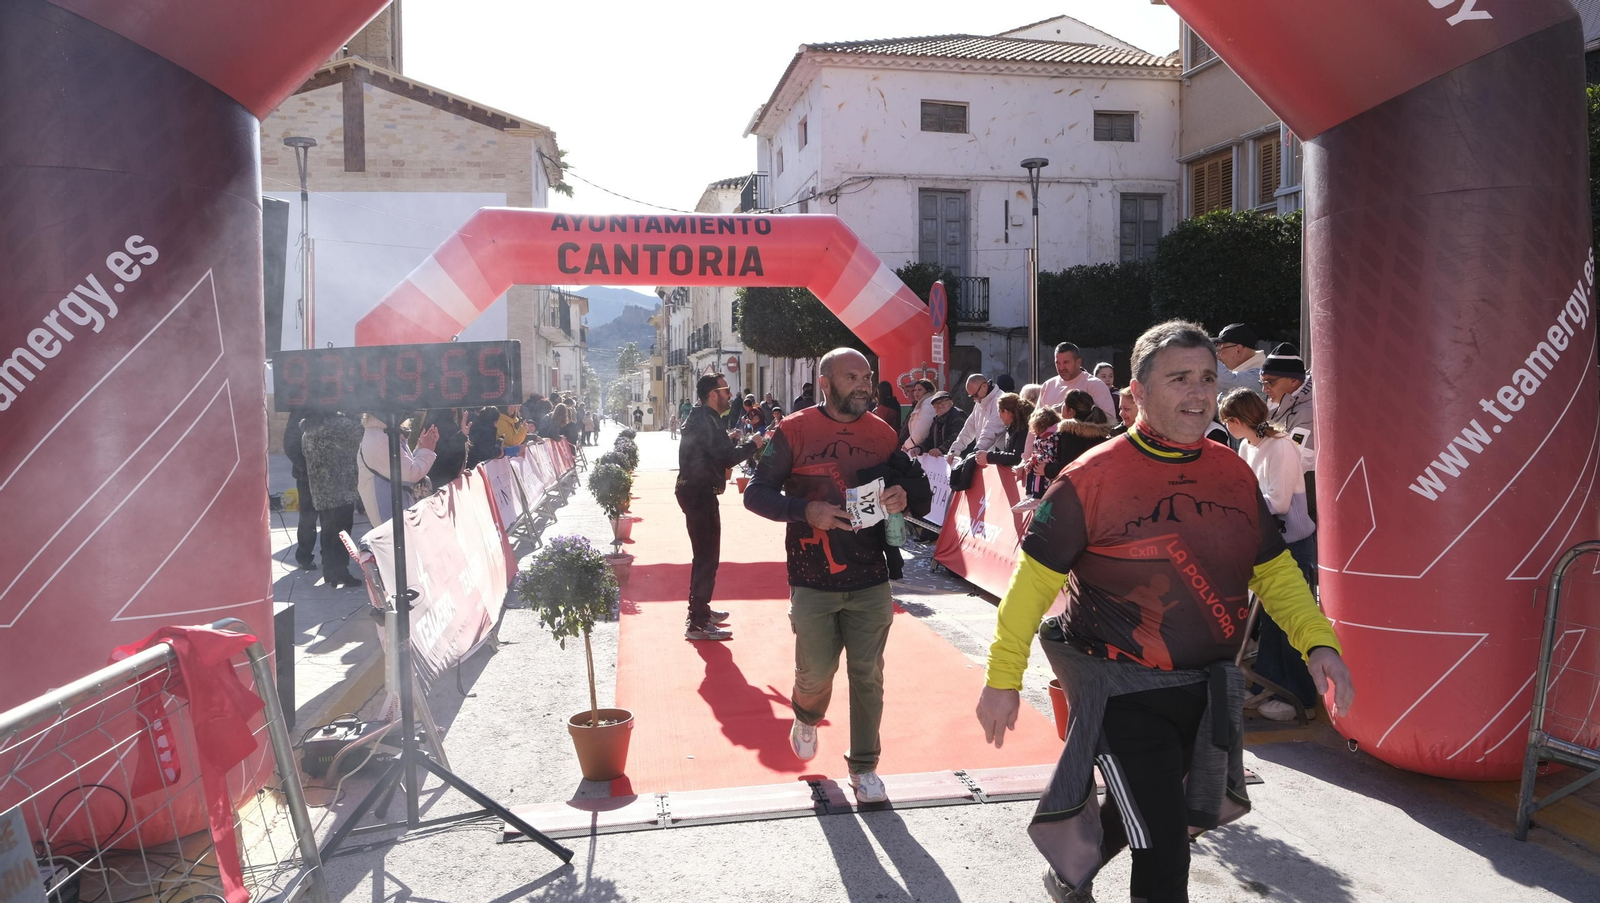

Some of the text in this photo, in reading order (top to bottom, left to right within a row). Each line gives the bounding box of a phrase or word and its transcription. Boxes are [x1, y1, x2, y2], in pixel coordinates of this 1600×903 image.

[550, 213, 772, 236] AYUNTAMIENTO
[557, 241, 765, 277] CANTORIA
[1408, 246, 1595, 501] www.teamergy.es
[859, 491, 876, 515] 421
[1165, 540, 1235, 639] LA POLVORA
